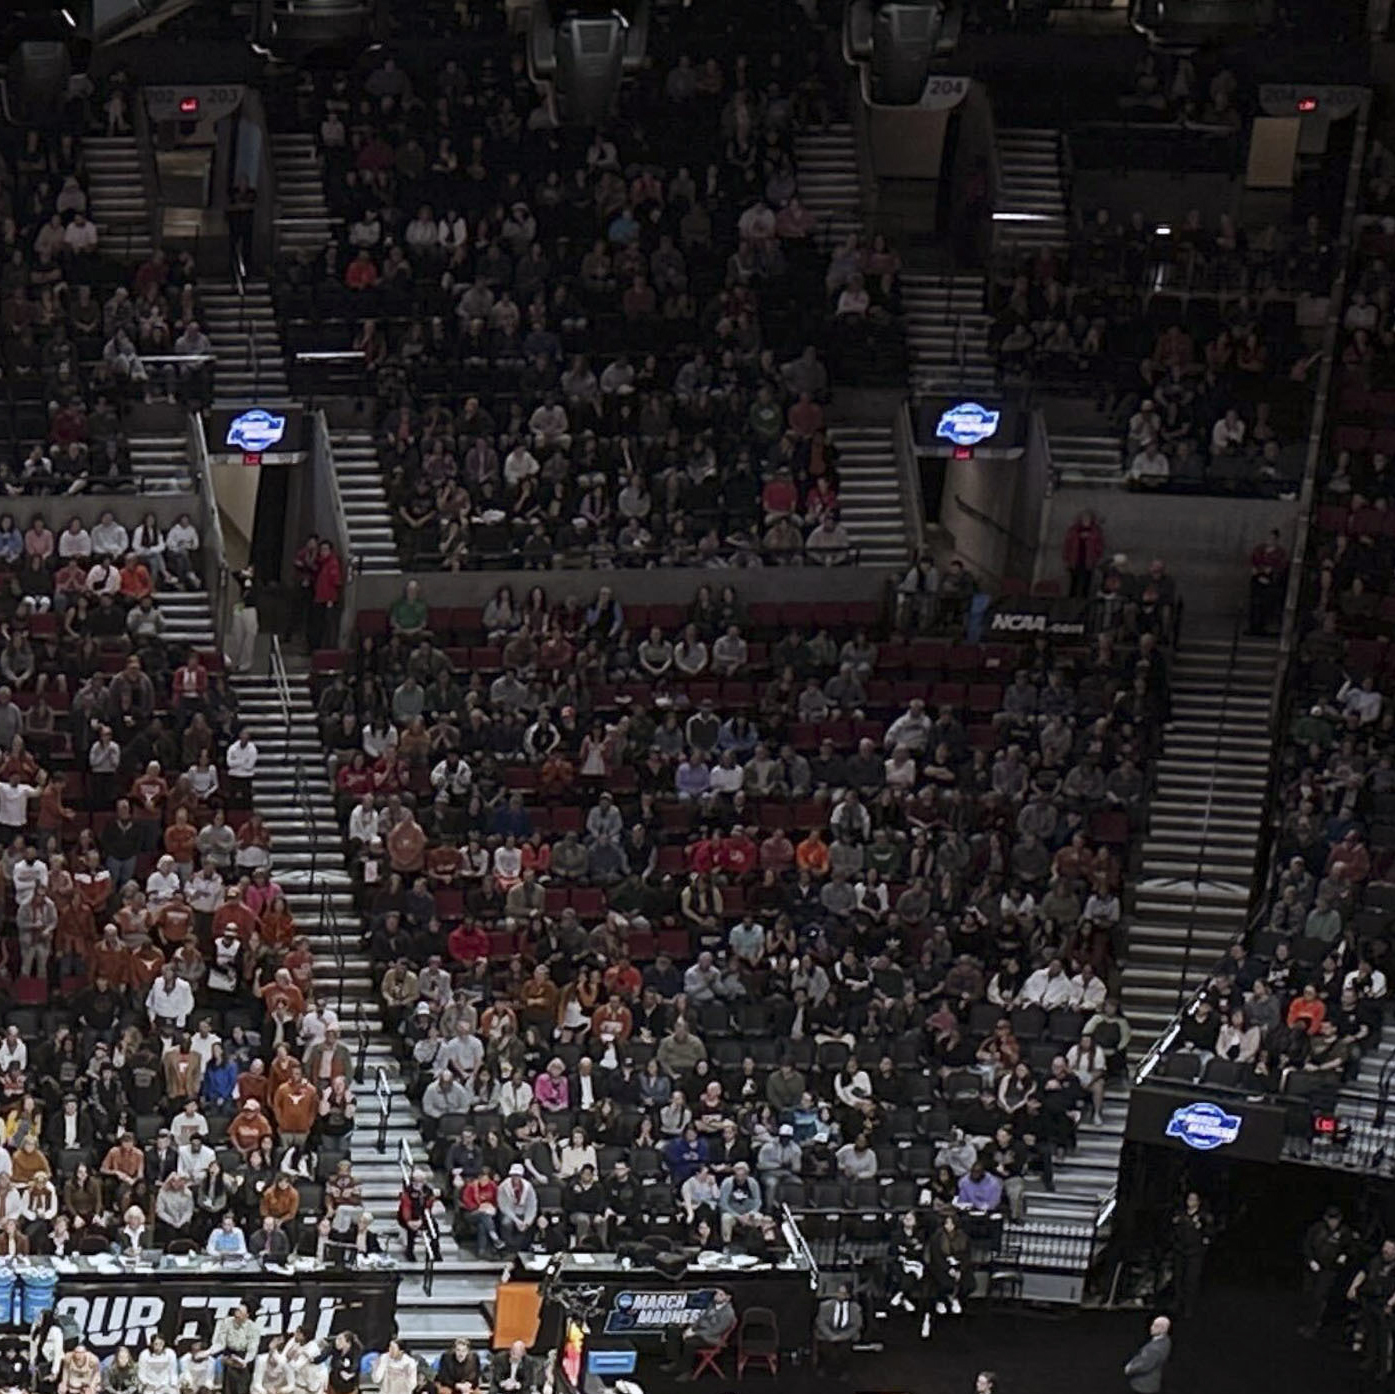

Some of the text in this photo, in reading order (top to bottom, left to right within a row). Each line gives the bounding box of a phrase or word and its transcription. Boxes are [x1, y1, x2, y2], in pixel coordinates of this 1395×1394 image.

[929, 80, 964, 96] 204
[632, 1293, 687, 1309] MARCH
[54, 1296, 166, 1346] OUR
